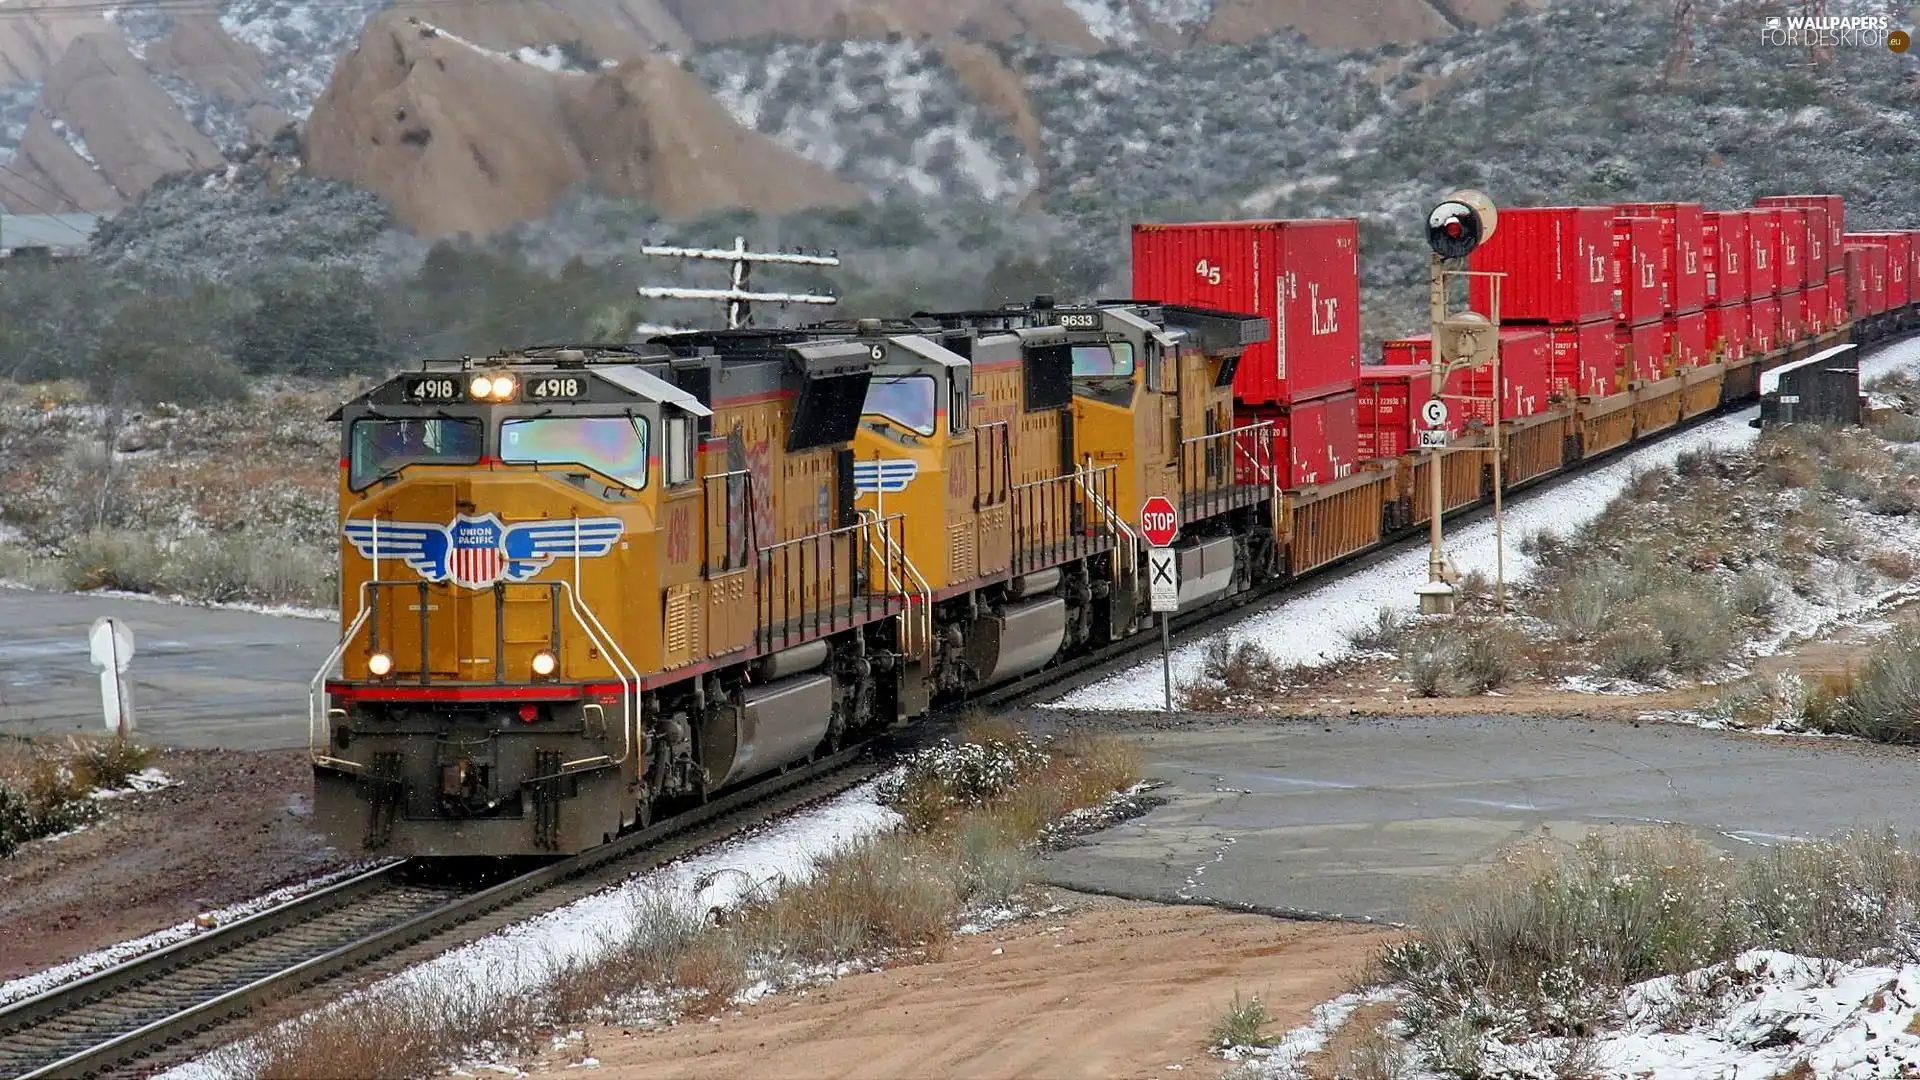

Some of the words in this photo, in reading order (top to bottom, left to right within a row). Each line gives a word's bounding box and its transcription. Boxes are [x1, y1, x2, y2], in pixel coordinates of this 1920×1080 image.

[1196, 259, 1221, 285] 45
[1061, 315, 1093, 326] 9633
[414, 380, 453, 399] 4918
[535, 378, 578, 398] 4918
[1428, 404, 1441, 421] G
[1143, 512, 1175, 531] STOP
[458, 536, 494, 545] PACIFIC
[460, 527, 492, 536] UNION
